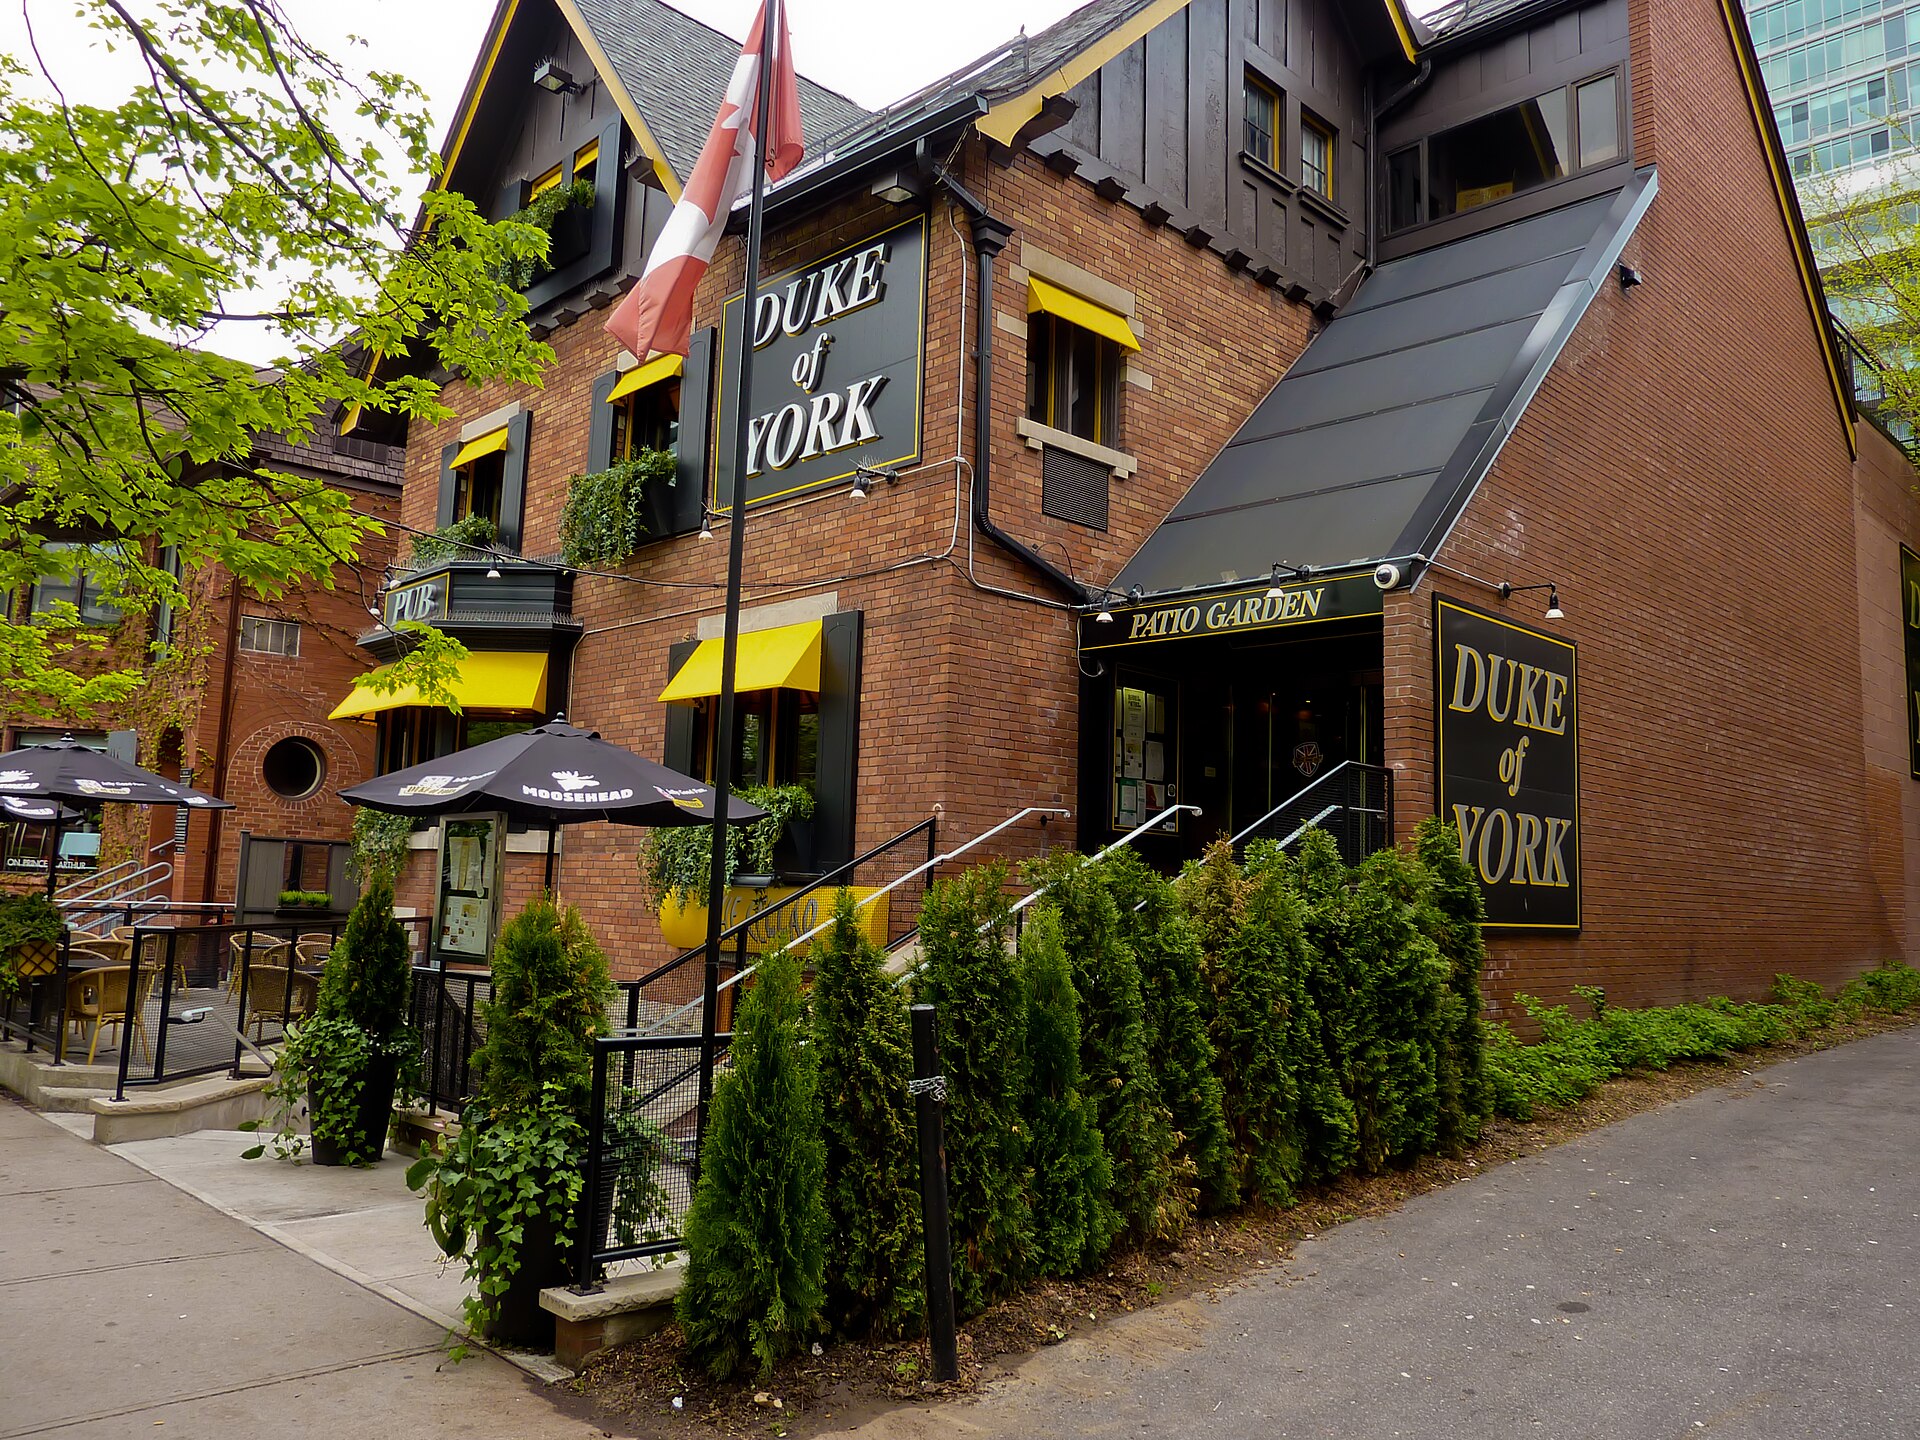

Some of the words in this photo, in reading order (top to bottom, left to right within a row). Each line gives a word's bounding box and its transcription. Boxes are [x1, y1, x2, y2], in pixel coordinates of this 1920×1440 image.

[753, 243, 889, 352] DUKE
[791, 333, 834, 393] of
[747, 375, 889, 479] YORK
[391, 583, 437, 627] PUB
[1128, 605, 1200, 639] PATIO
[1206, 587, 1325, 630] GARDEN
[1449, 643, 1568, 736] DUKE
[522, 784, 634, 803] MOOSEHEAD
[1499, 735, 1530, 796] of
[1452, 803, 1573, 888] YORK
